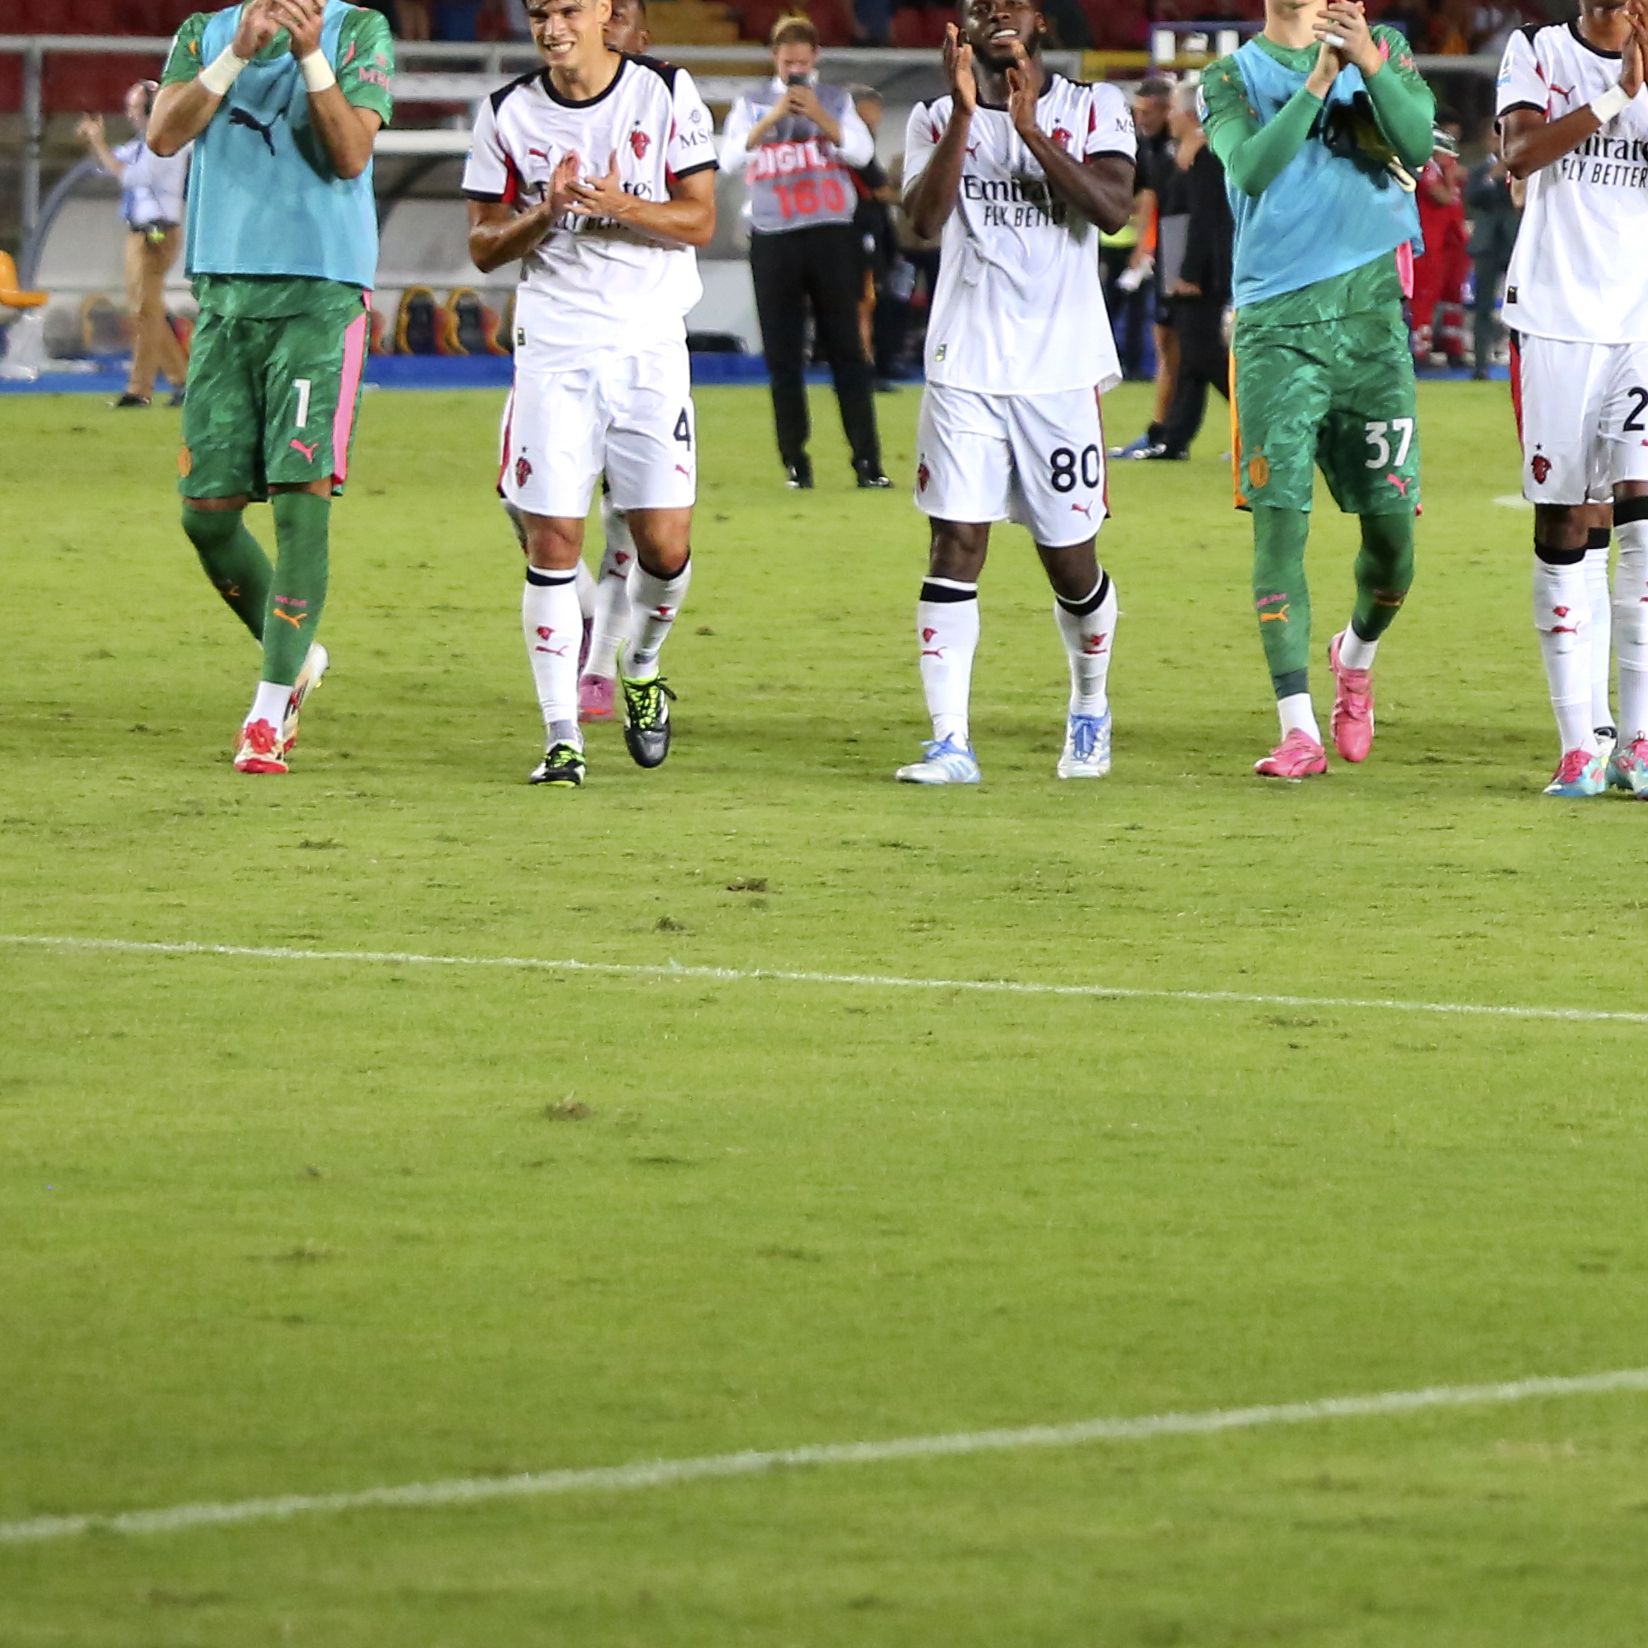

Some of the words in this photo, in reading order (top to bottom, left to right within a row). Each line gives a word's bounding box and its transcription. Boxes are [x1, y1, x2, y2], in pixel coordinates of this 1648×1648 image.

[680, 128, 714, 149] MS
[1562, 158, 1587, 182] FLY
[1591, 162, 1648, 189] BETTER
[291, 379, 312, 428] 1
[673, 407, 691, 452] 4
[1365, 417, 1413, 470] 37
[1050, 443, 1100, 493] 80
